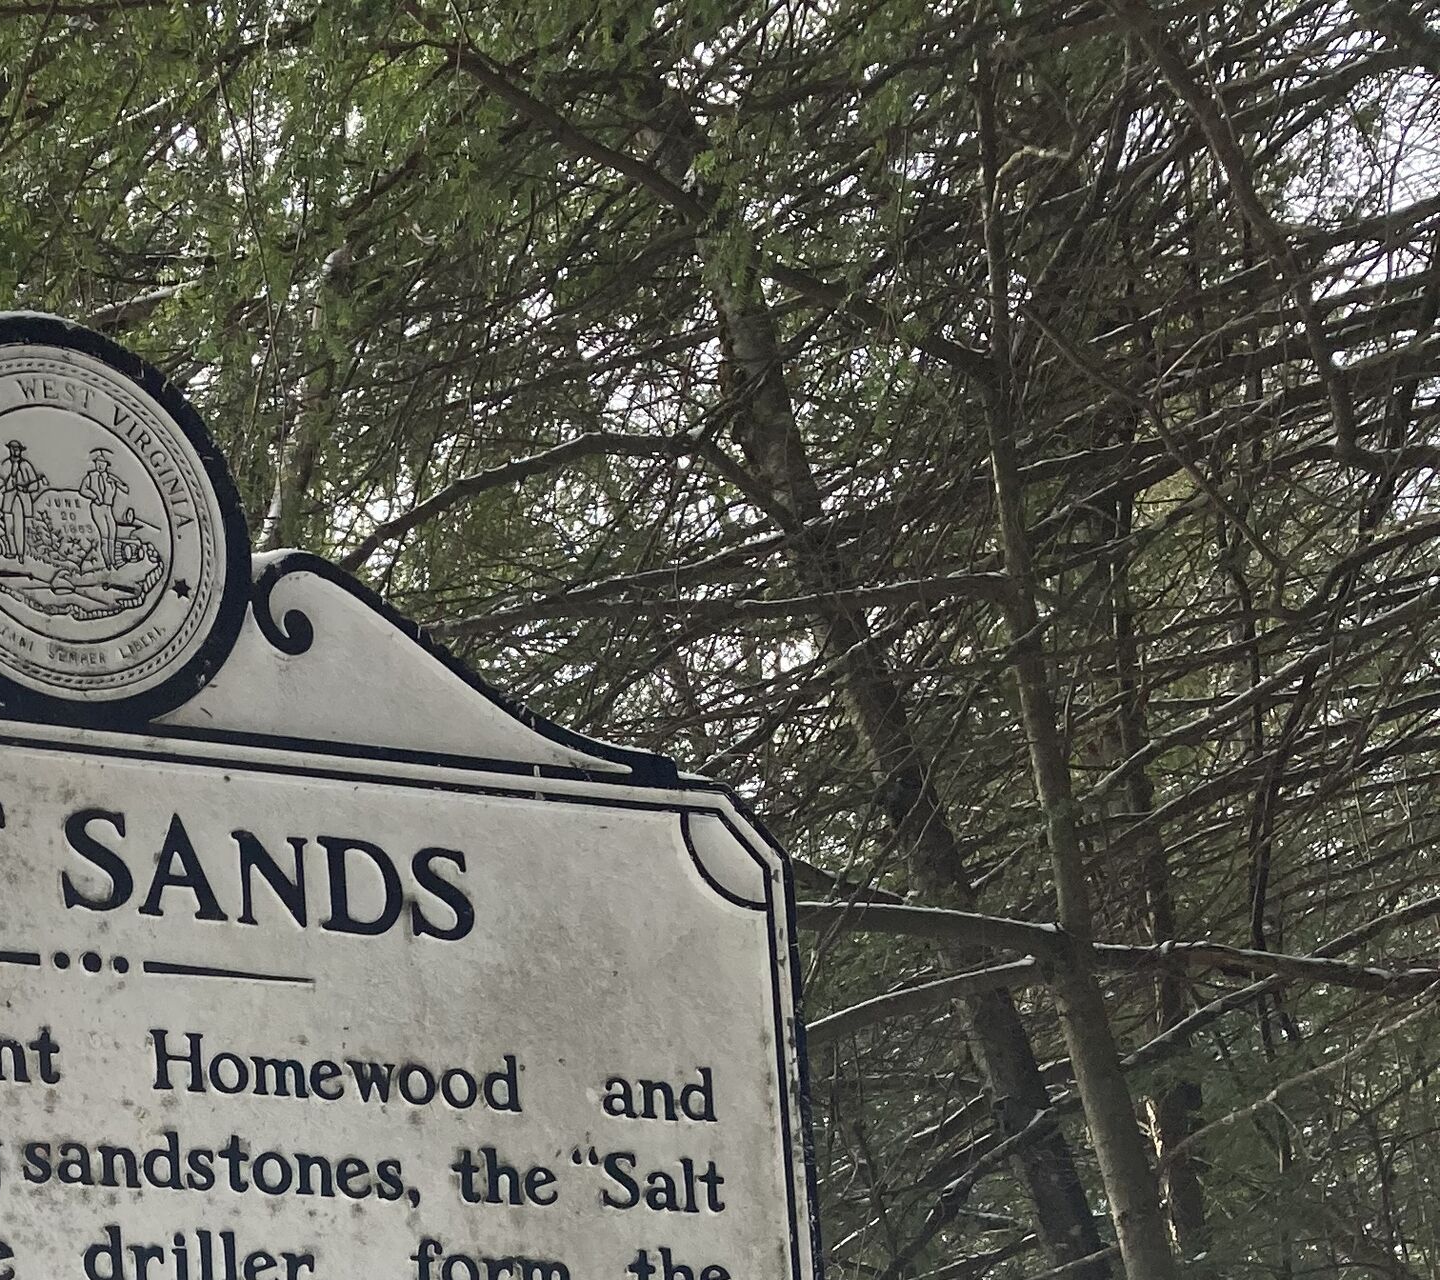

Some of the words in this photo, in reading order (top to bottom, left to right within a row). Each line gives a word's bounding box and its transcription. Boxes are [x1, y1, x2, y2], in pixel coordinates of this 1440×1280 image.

[16, 378, 95, 410] WEST
[45, 498, 81, 508] JUNE
[60, 511, 77, 521] 20
[62, 809, 475, 941] SANDS
[149, 1029, 522, 1113] Homewood
[602, 1067, 718, 1123] and
[22, 1131, 421, 1208] sandstones,
[452, 1147, 558, 1206] the
